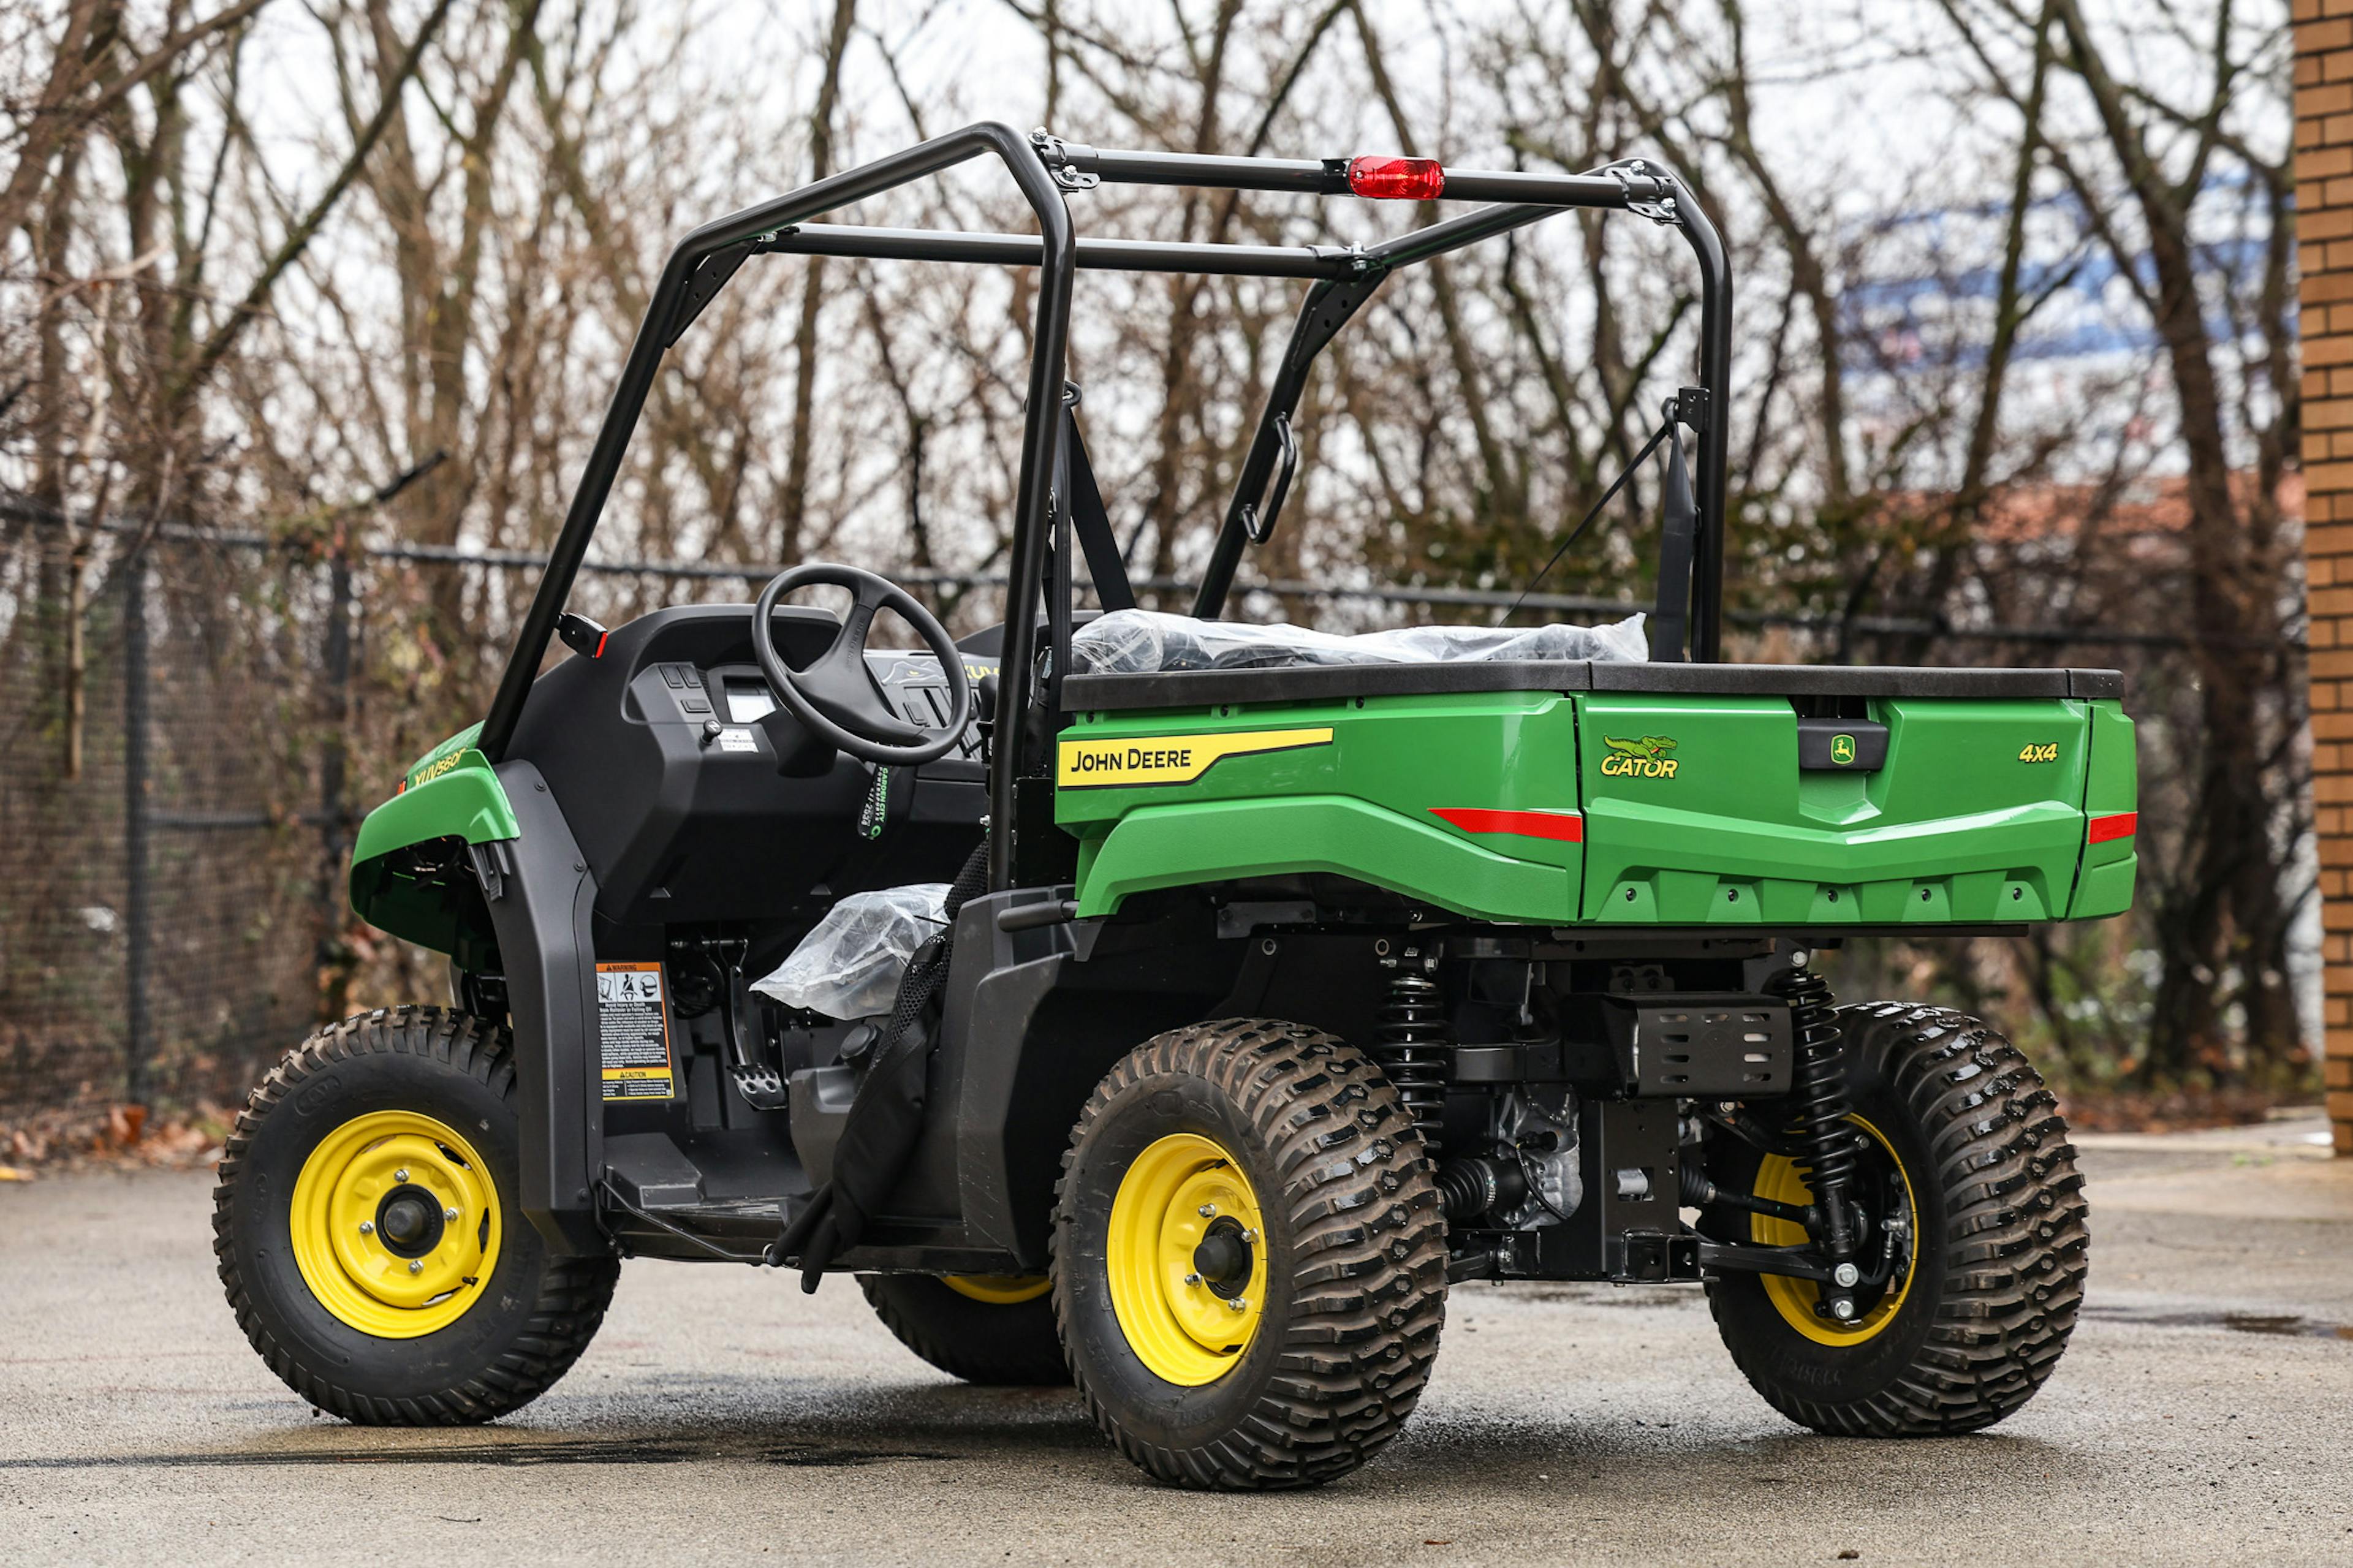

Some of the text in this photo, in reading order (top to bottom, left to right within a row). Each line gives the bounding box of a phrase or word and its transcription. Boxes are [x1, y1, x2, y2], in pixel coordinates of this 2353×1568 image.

[1071, 749, 1192, 772] JOHN DEERE
[1601, 755, 1678, 779] GATOR
